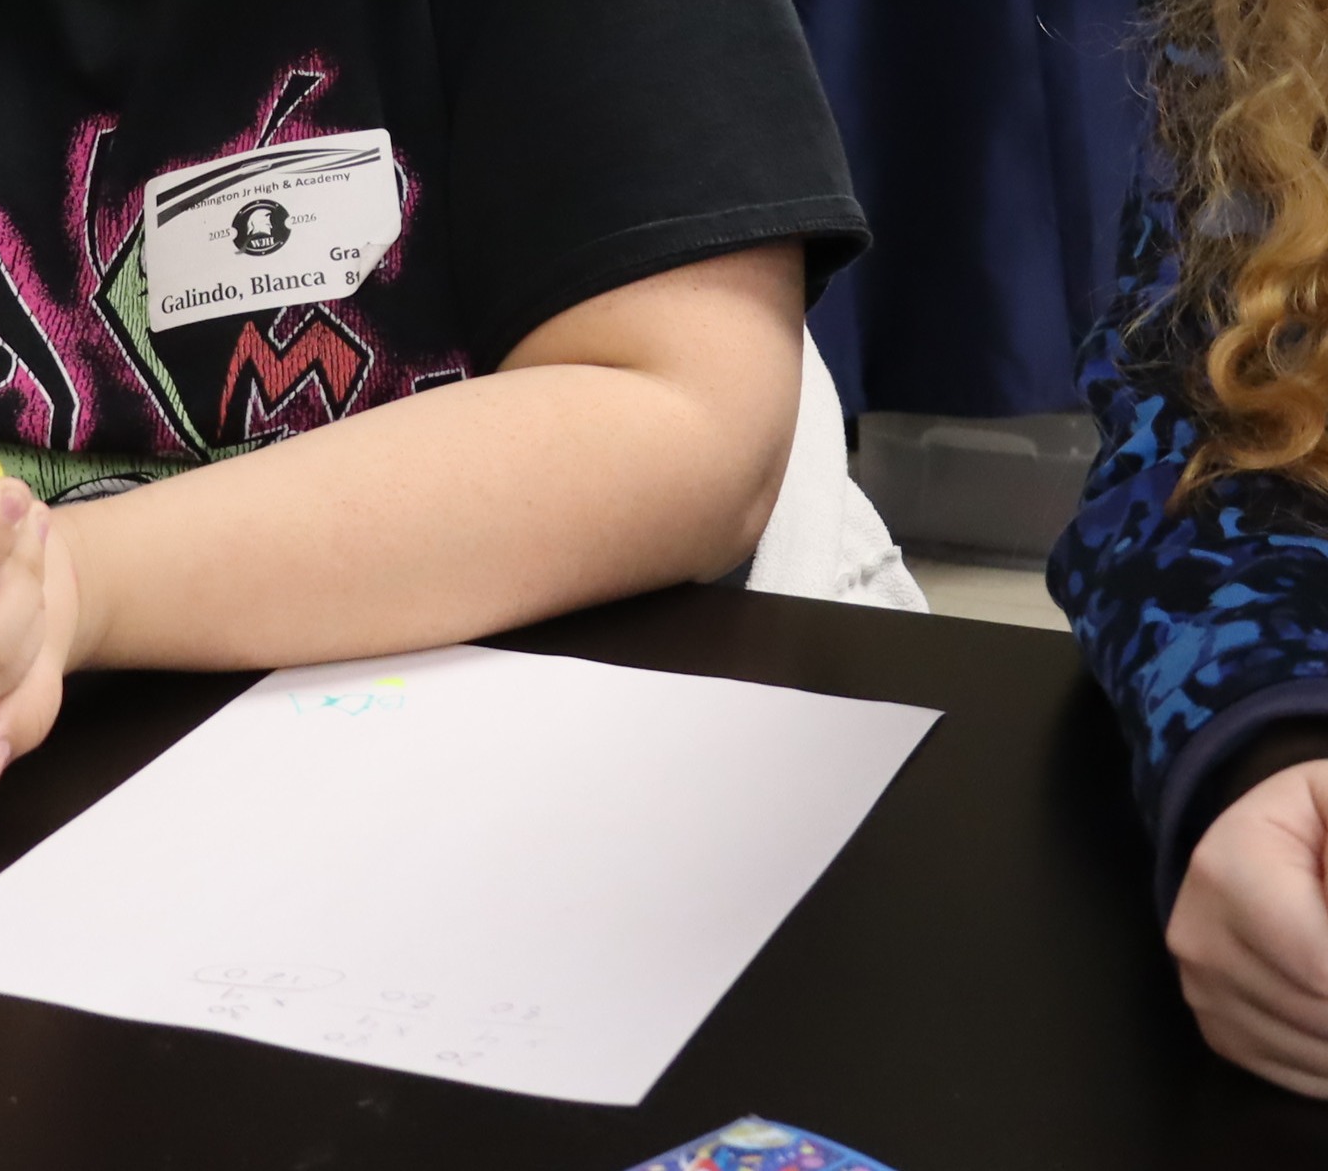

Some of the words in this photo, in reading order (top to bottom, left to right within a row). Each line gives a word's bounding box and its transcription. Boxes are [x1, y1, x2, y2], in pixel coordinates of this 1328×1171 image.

[184, 191, 240, 212] shington
[243, 188, 251, 198] Jr
[254, 182, 279, 196] High
[282, 180, 292, 189] &
[296, 172, 351, 188] Academy
[290, 213, 317, 225] 2026
[208, 229, 231, 241] 2025
[251, 236, 275, 248] WJH
[329, 246, 360, 262] Gra
[161, 282, 244, 315] Galindo,
[250, 270, 327, 296] Blanca
